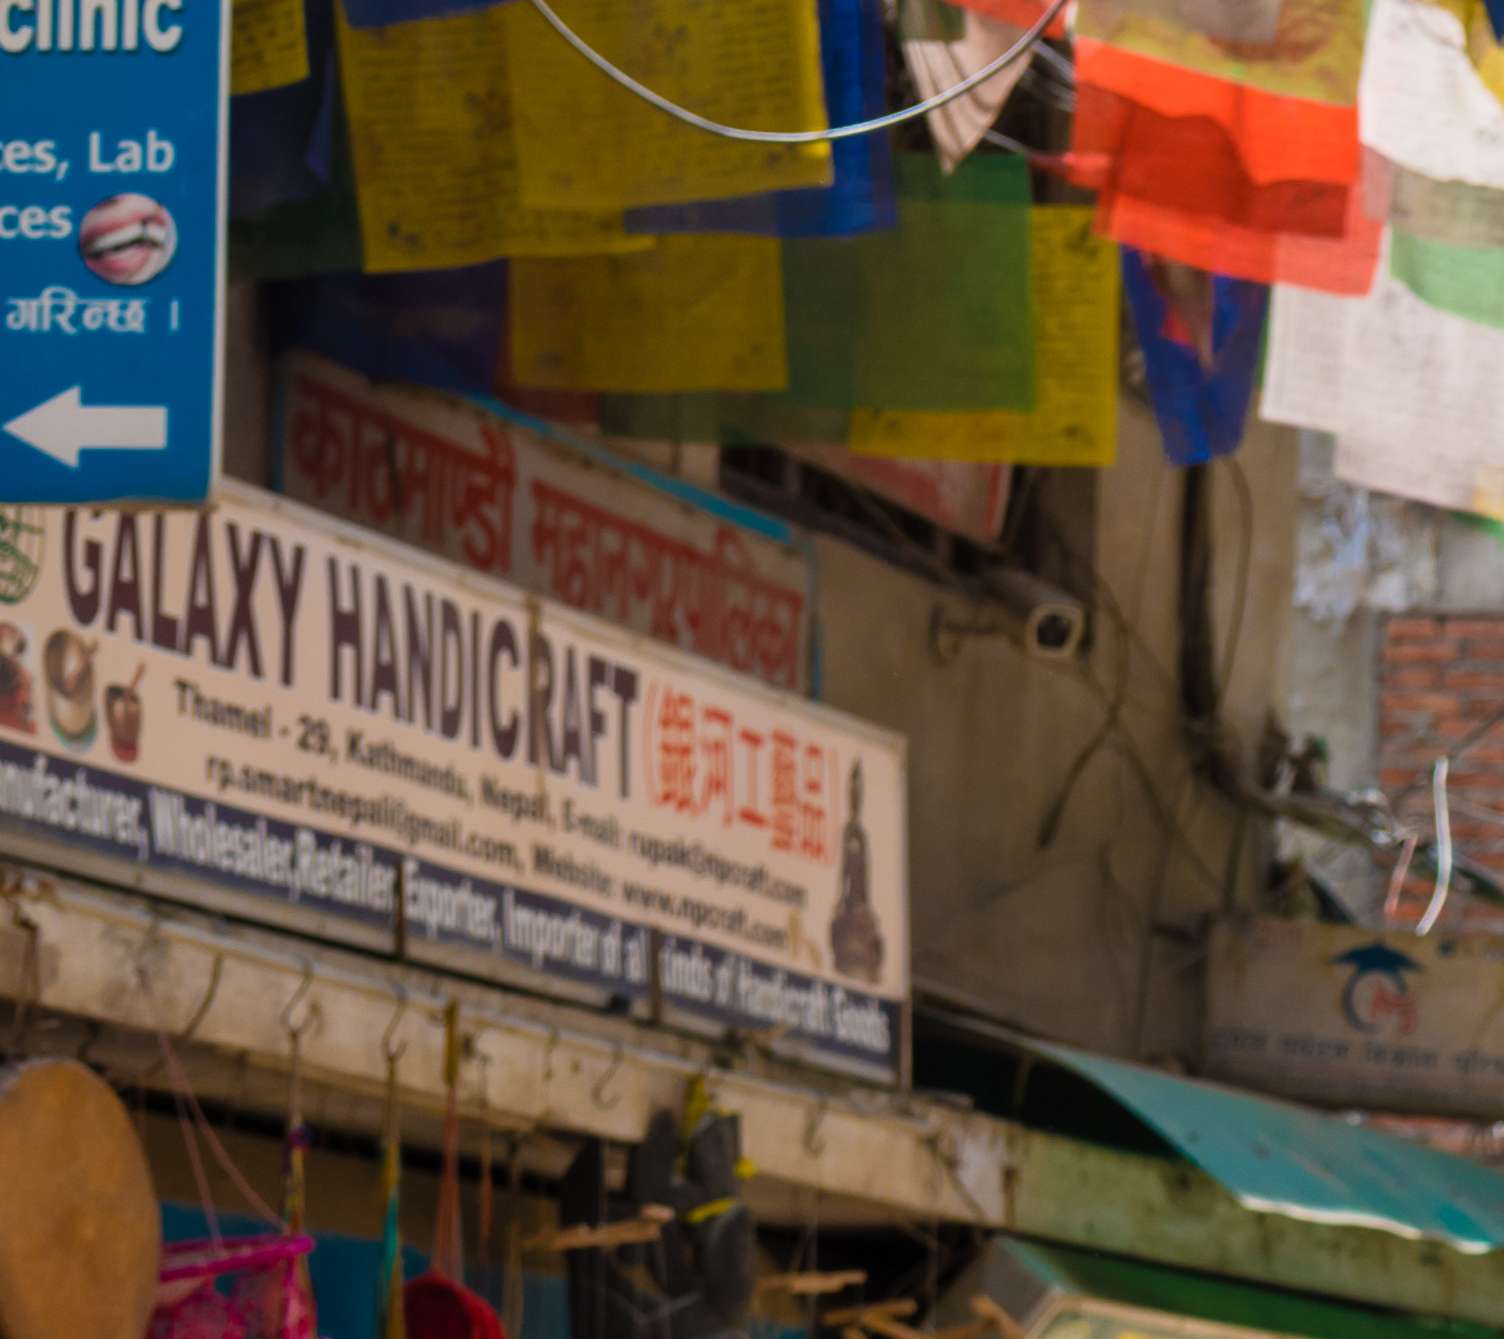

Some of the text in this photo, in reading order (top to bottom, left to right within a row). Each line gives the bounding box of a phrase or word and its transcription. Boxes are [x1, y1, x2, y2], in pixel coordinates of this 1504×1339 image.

[0, 131, 174, 181] es, Lab
[64, 510, 639, 799] GALAXY HANDICRAFT
